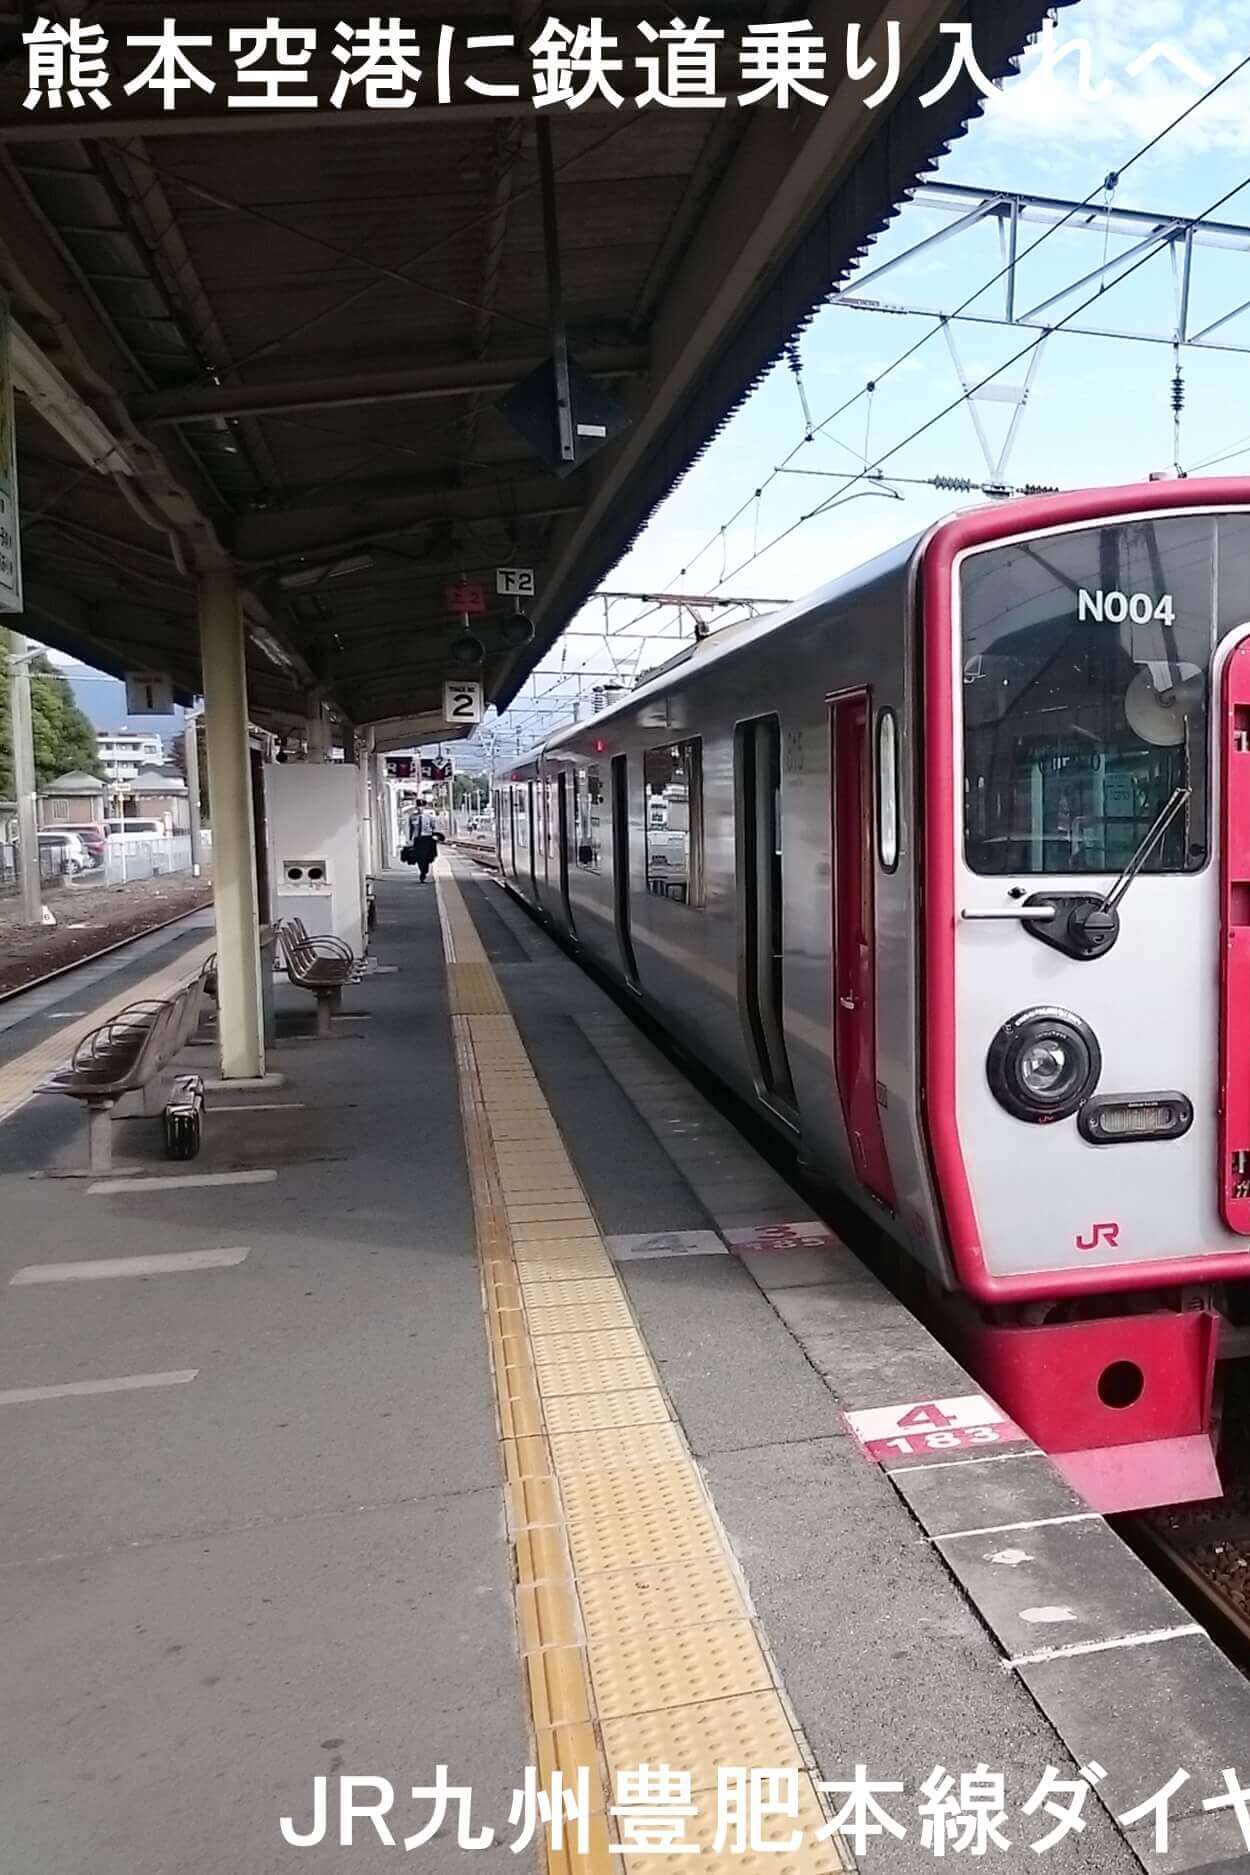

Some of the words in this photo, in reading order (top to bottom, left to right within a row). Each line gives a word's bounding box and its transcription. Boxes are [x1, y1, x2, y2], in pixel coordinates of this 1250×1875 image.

[499, 571, 532, 591] 下2
[1078, 589, 1176, 626] N004
[452, 694, 474, 717] 2
[1076, 1223, 1119, 1250] JR
[896, 1404, 958, 1428] 4
[886, 1427, 999, 1454] 183
